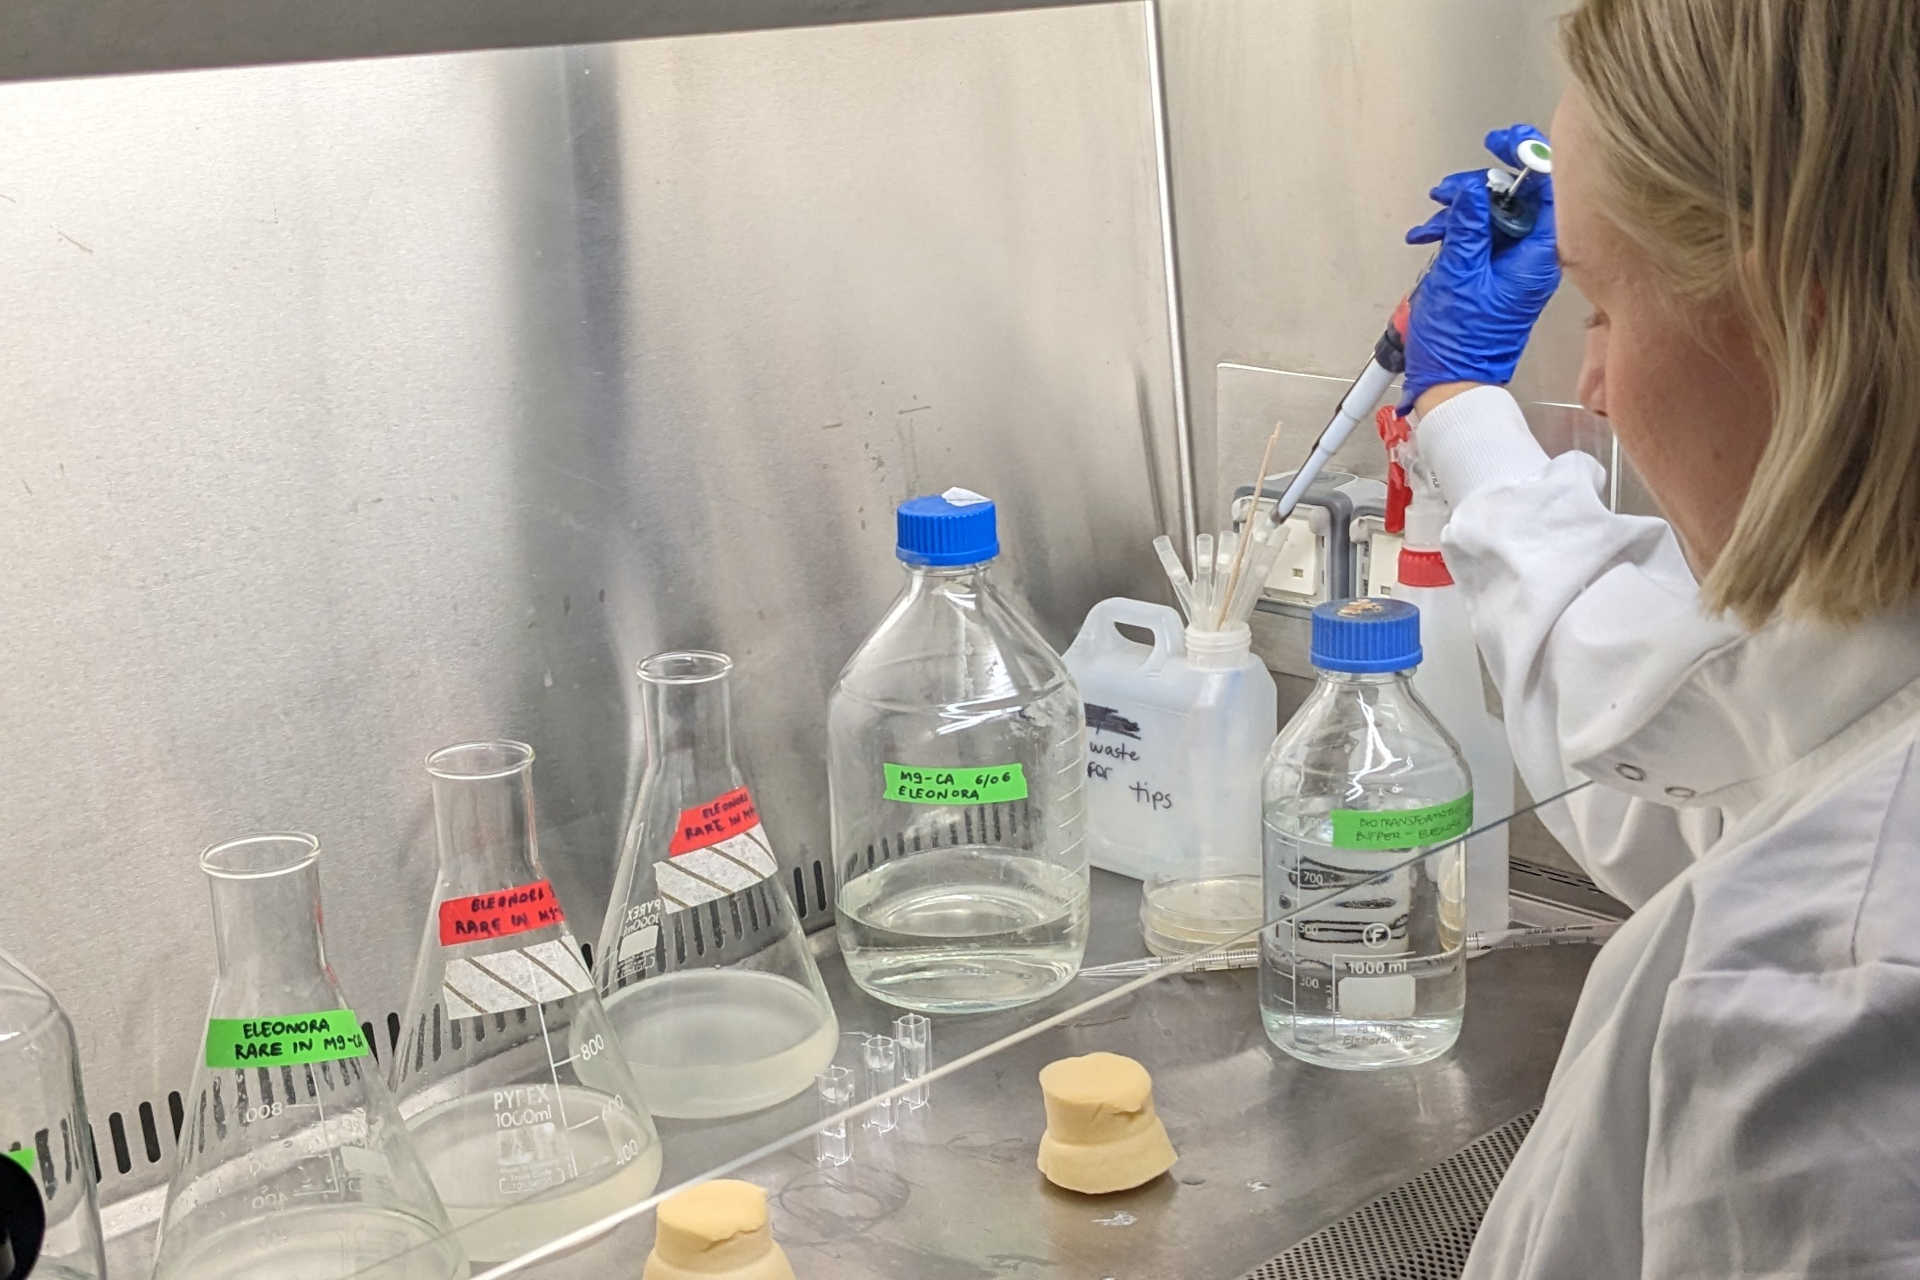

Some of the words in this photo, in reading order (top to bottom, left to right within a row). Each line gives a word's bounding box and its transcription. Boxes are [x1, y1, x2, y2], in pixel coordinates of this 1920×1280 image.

[1089, 741, 1141, 762] waste
[975, 771, 1012, 789] 6/06
[898, 785, 980, 801] ELEONORA
[1128, 781, 1174, 811] tips
[1303, 872, 1324, 886] 700
[1349, 961, 1385, 975] 1000
[243, 1018, 331, 1040] ELEONORA
[234, 1042, 284, 1061] RARE
[293, 1038, 314, 1054] IN
[580, 1034, 605, 1062] 800
